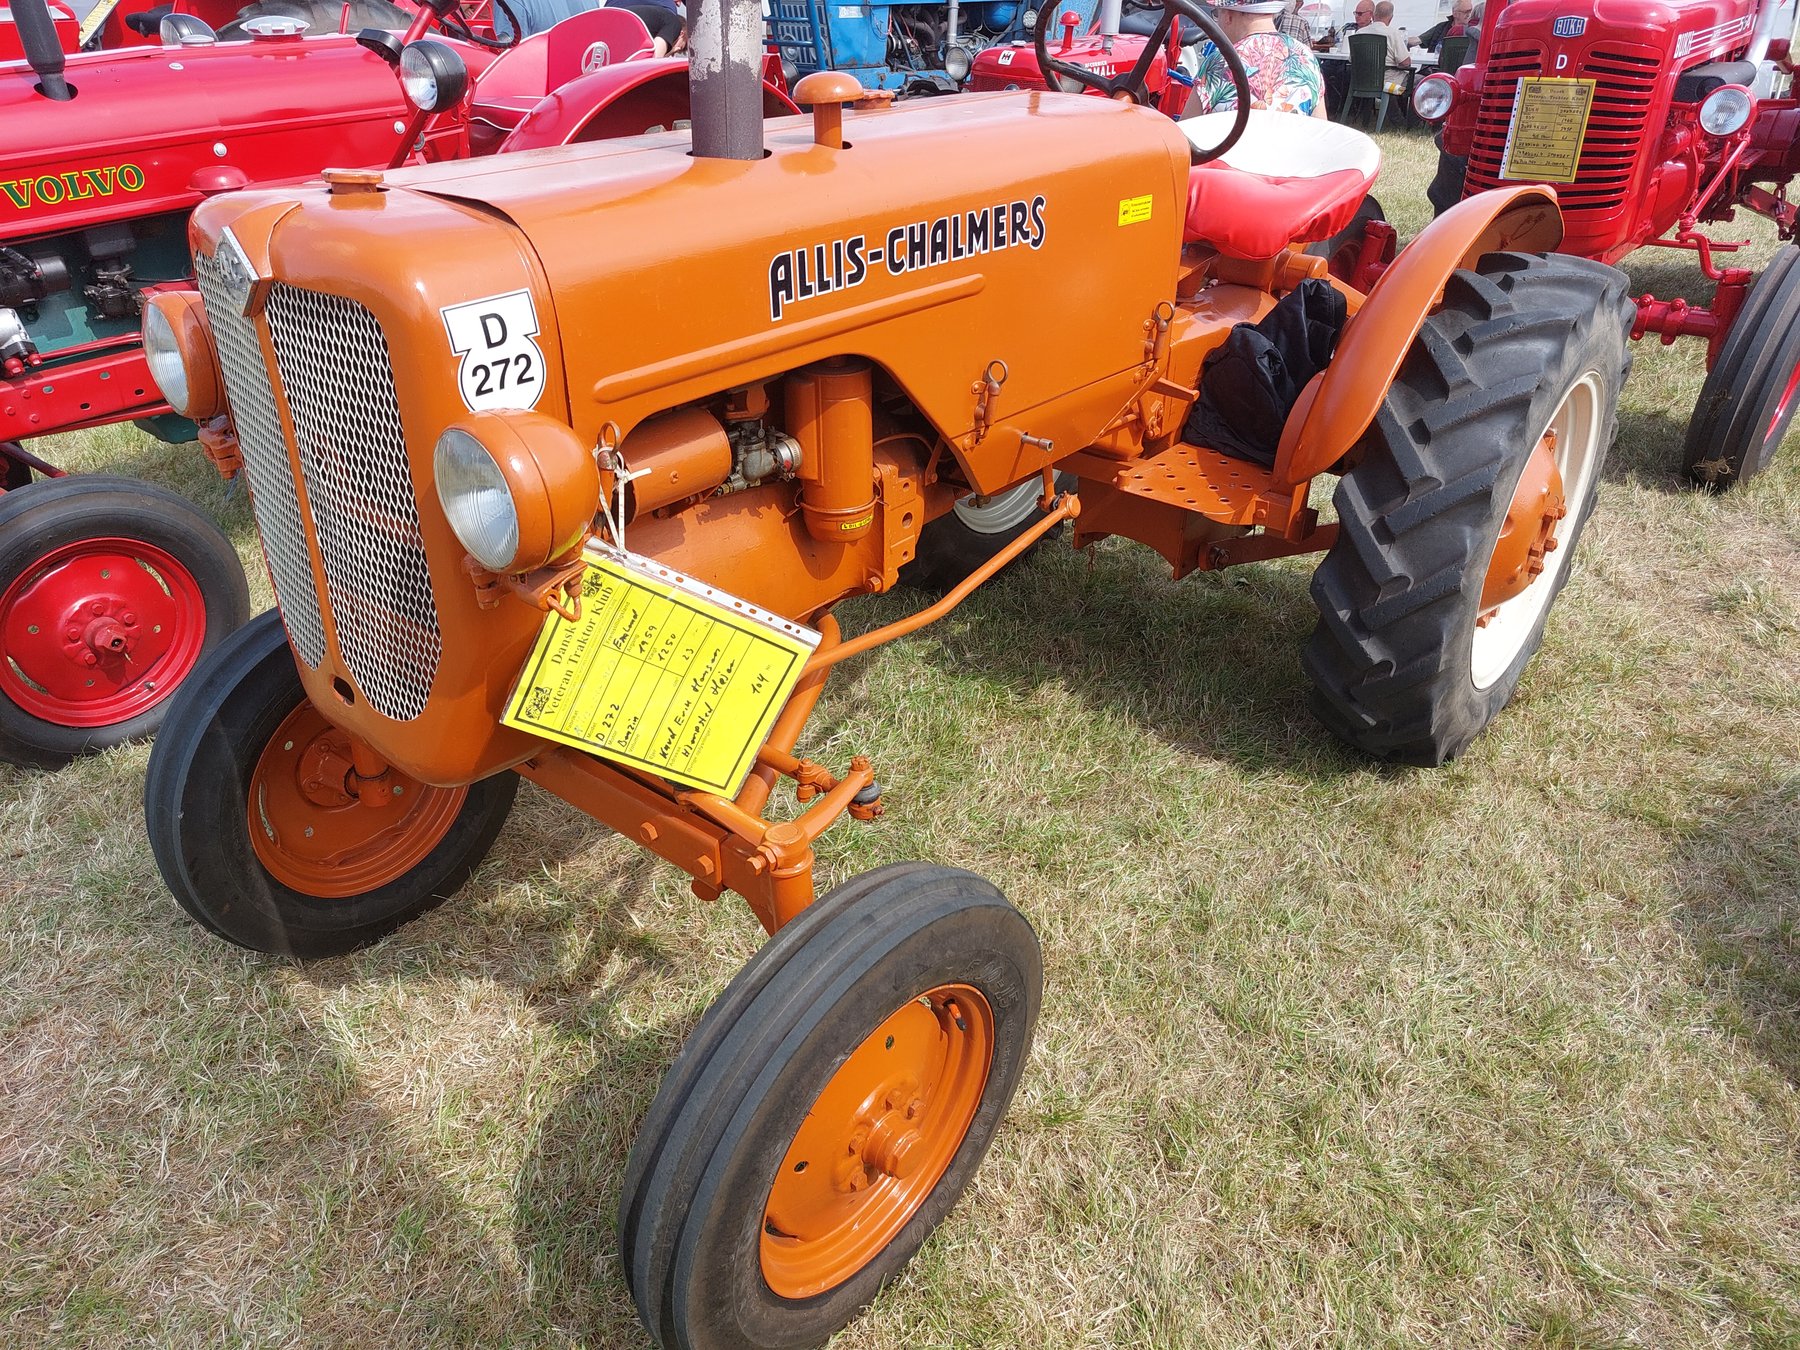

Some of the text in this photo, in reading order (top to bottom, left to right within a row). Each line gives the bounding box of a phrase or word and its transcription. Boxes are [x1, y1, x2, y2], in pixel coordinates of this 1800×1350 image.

[1556, 19, 1583, 34] BUKH
[1674, 31, 1695, 58] BUKH
[1556, 54, 1568, 70] D
[0, 164, 145, 209] VOLVO
[768, 195, 1046, 322] ALLIS-CHALMERS
[479, 313, 508, 349] D
[472, 353, 534, 397] 272
[543, 667, 575, 717] Veteran
[565, 615, 599, 668] Traktor
[588, 583, 615, 616] Klub
[549, 623, 578, 665] Dansk
[634, 623, 658, 655] 1959
[654, 630, 678, 663] 1250
[747, 671, 771, 697] 104
[593, 701, 621, 741] D 272
